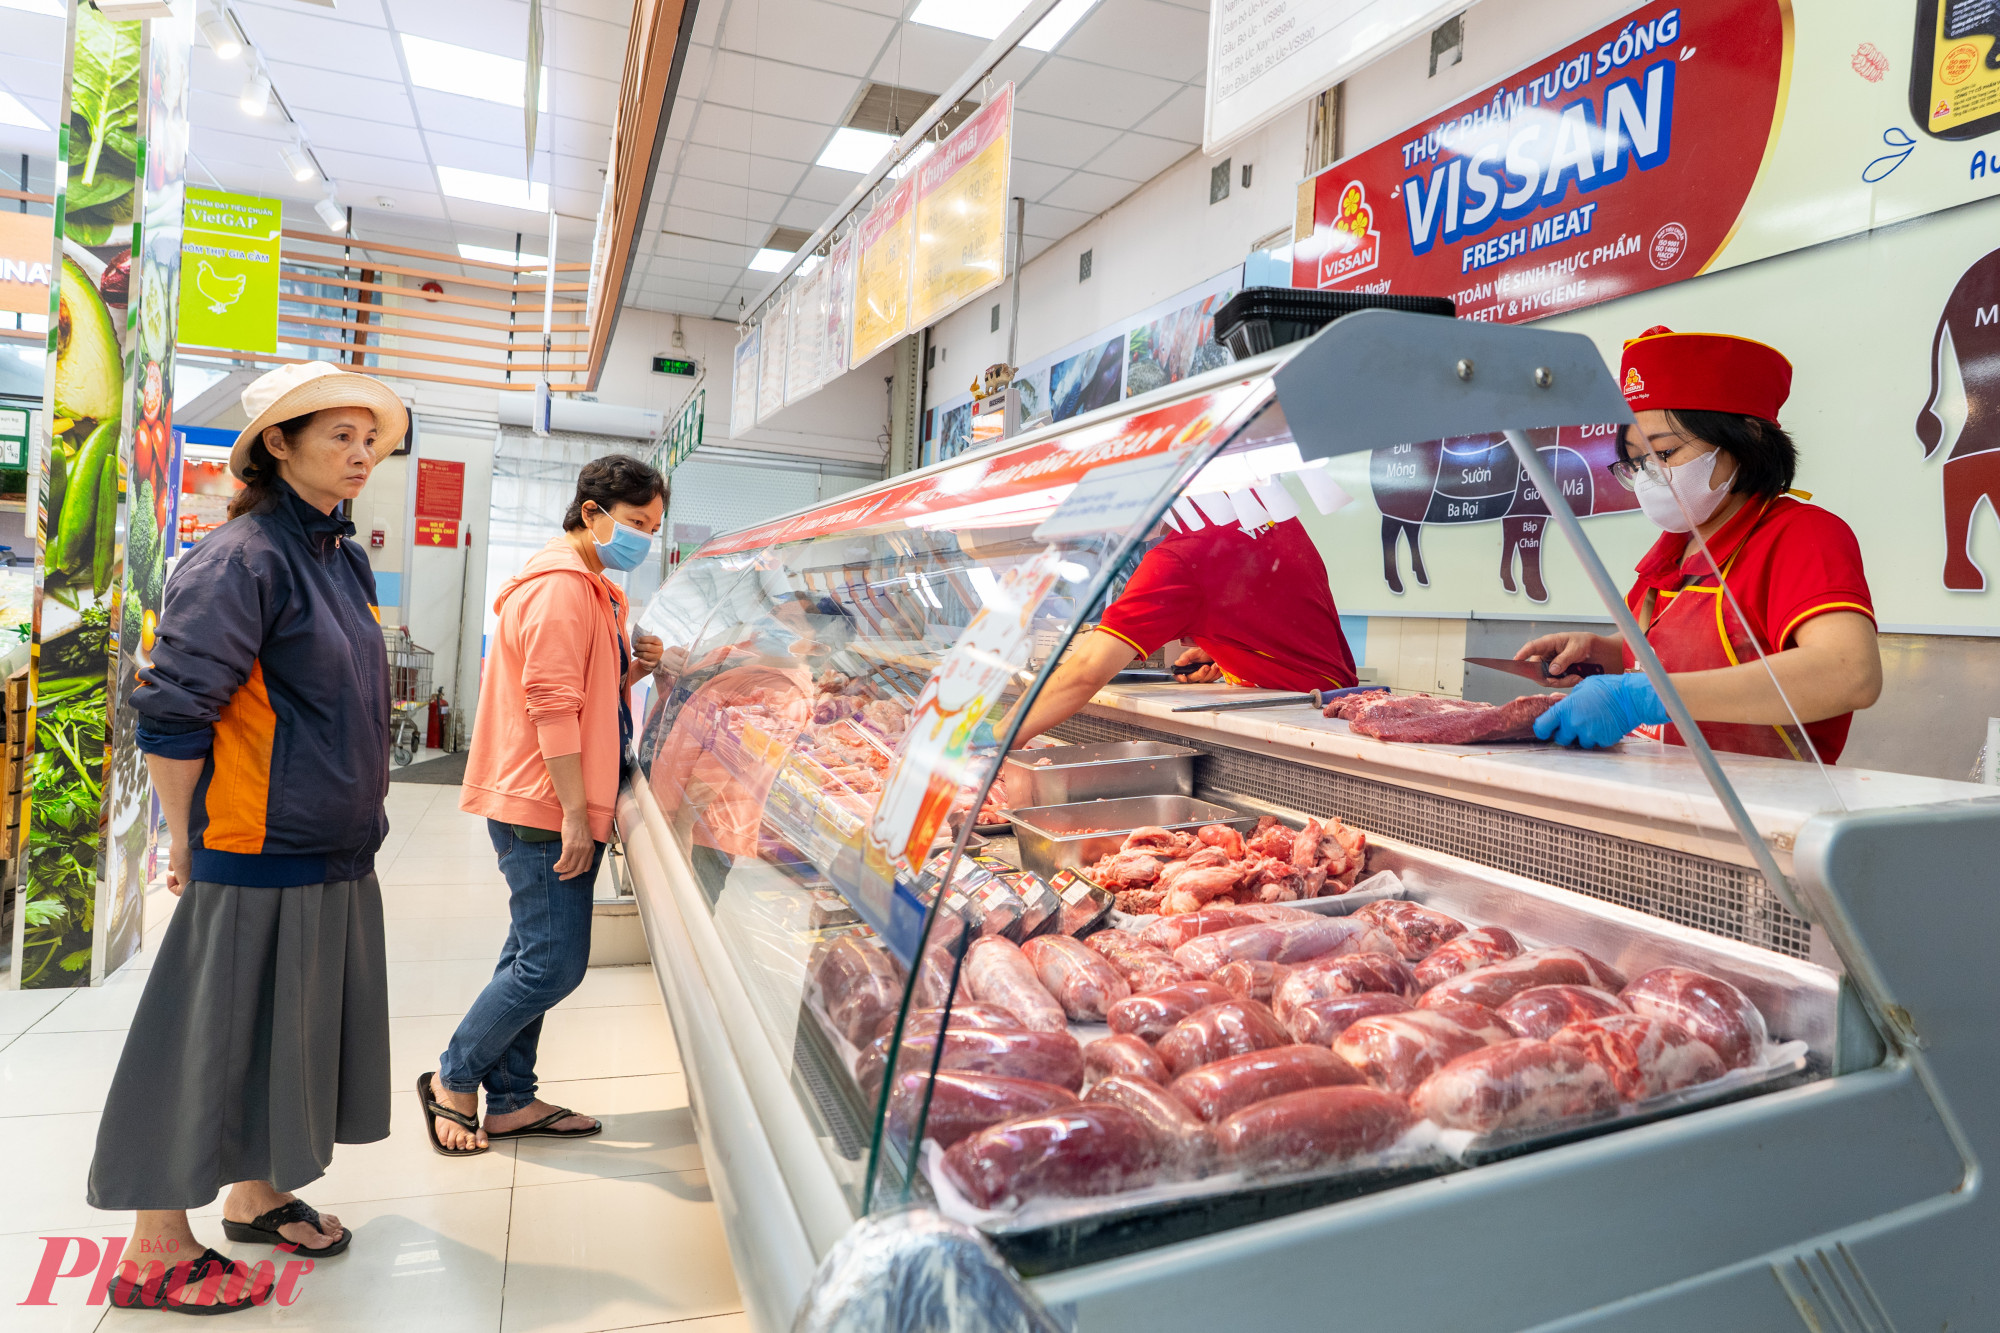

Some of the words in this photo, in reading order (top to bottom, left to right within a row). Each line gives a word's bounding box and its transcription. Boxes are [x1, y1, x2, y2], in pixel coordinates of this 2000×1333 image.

[1402, 119, 1457, 168] THỰC
[1460, 88, 1524, 141] PHẨM
[1528, 53, 1591, 105] TƯƠI
[1595, 9, 1679, 75] SỐNG
[920, 141, 957, 191] Khuyến
[957, 126, 978, 162] mãi
[1403, 65, 1665, 246] VISSAN
[190, 208, 259, 230] VietGAP
[1462, 228, 1526, 272] FRESH
[1530, 204, 1595, 249] MEAT
[1324, 248, 1373, 278] VISSAN
[1457, 283, 1492, 306] TOÀN
[1494, 273, 1511, 296] VỆ
[1512, 266, 1547, 290] SINH
[1547, 251, 1590, 278] THỰC
[1592, 233, 1642, 266] PHẨM
[1507, 299, 1518, 316] &
[1521, 279, 1587, 313] HYGIENE
[1069, 424, 1176, 468] VISSAN
[1386, 462, 1416, 478] Mông
[1461, 466, 1491, 484] Sườn
[1562, 478, 1584, 496] Má
[1447, 503, 1460, 517] Ba
[1462, 502, 1479, 519] Rọi
[1523, 521, 1538, 533] Bắp
[1519, 537, 1539, 549] Chân
